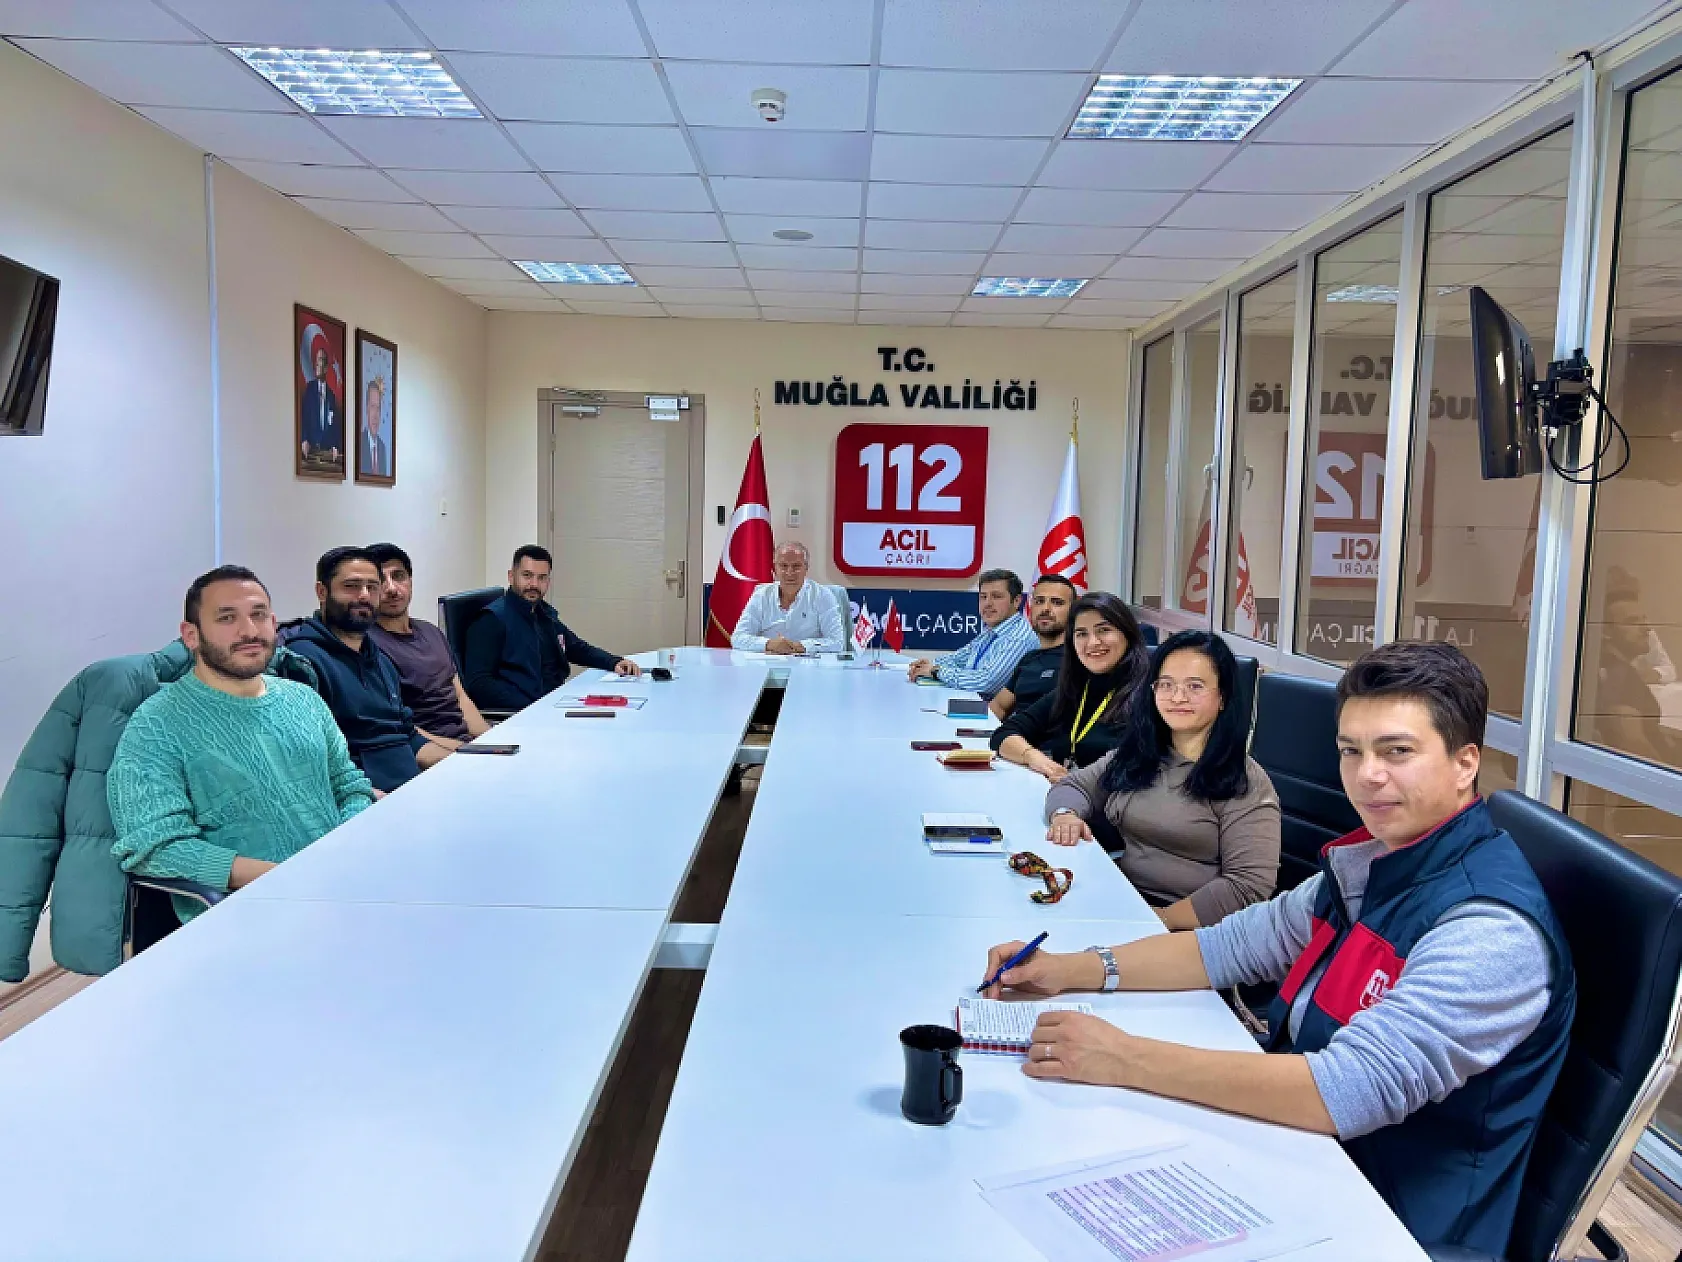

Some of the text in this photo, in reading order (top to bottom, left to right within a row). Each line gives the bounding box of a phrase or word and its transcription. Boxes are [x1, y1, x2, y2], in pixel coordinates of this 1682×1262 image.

[878, 347, 935, 372] T.C.
[774, 375, 1037, 411] MUĞLA VALİLİĞİ
[859, 443, 963, 512] 112
[879, 528, 937, 551] ACİL
[885, 552, 930, 565] ÇAĞRI
